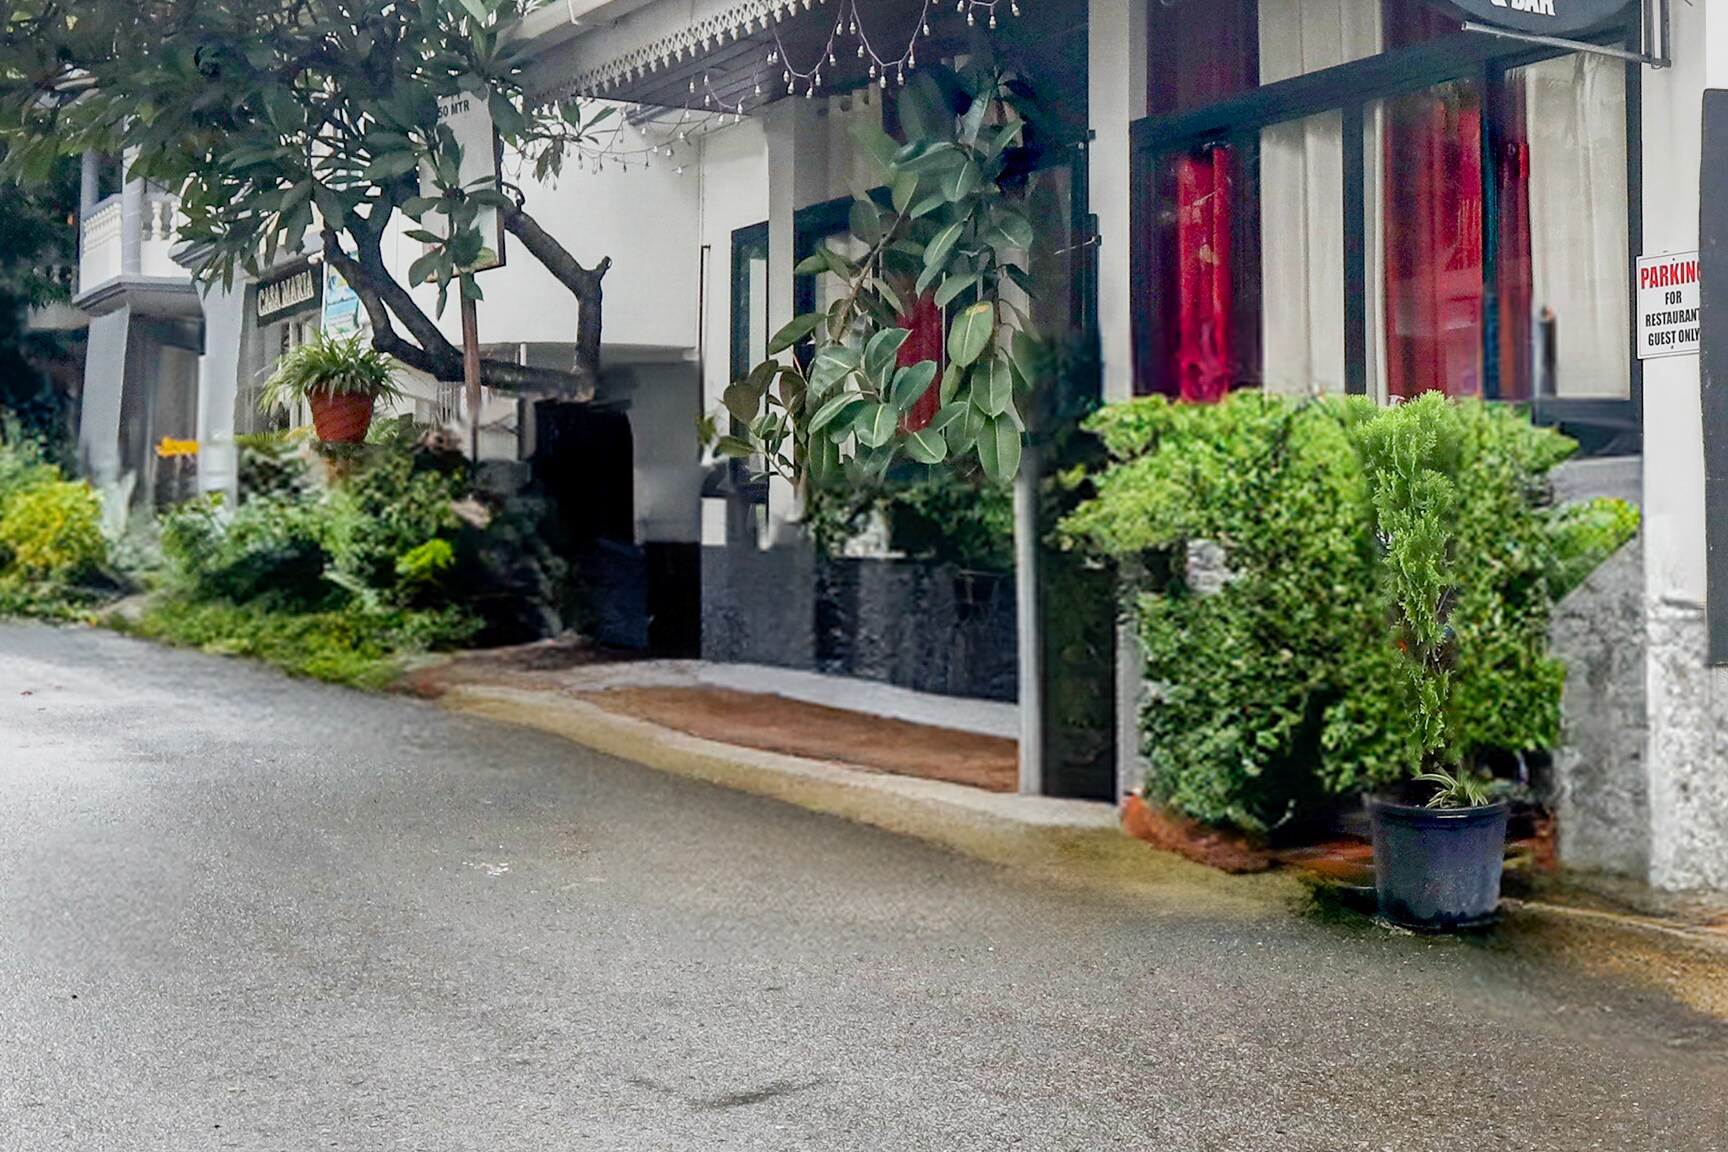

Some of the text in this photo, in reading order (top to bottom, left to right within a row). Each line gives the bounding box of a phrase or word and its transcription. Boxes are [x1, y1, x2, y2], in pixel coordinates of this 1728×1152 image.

[451, 99, 470, 116] MTR
[1641, 260, 1701, 290] PARKIN
[258, 269, 315, 317] CASA MARIA
[1665, 290, 1682, 305] FOR
[1648, 327, 1700, 346] GUEST ONLY
